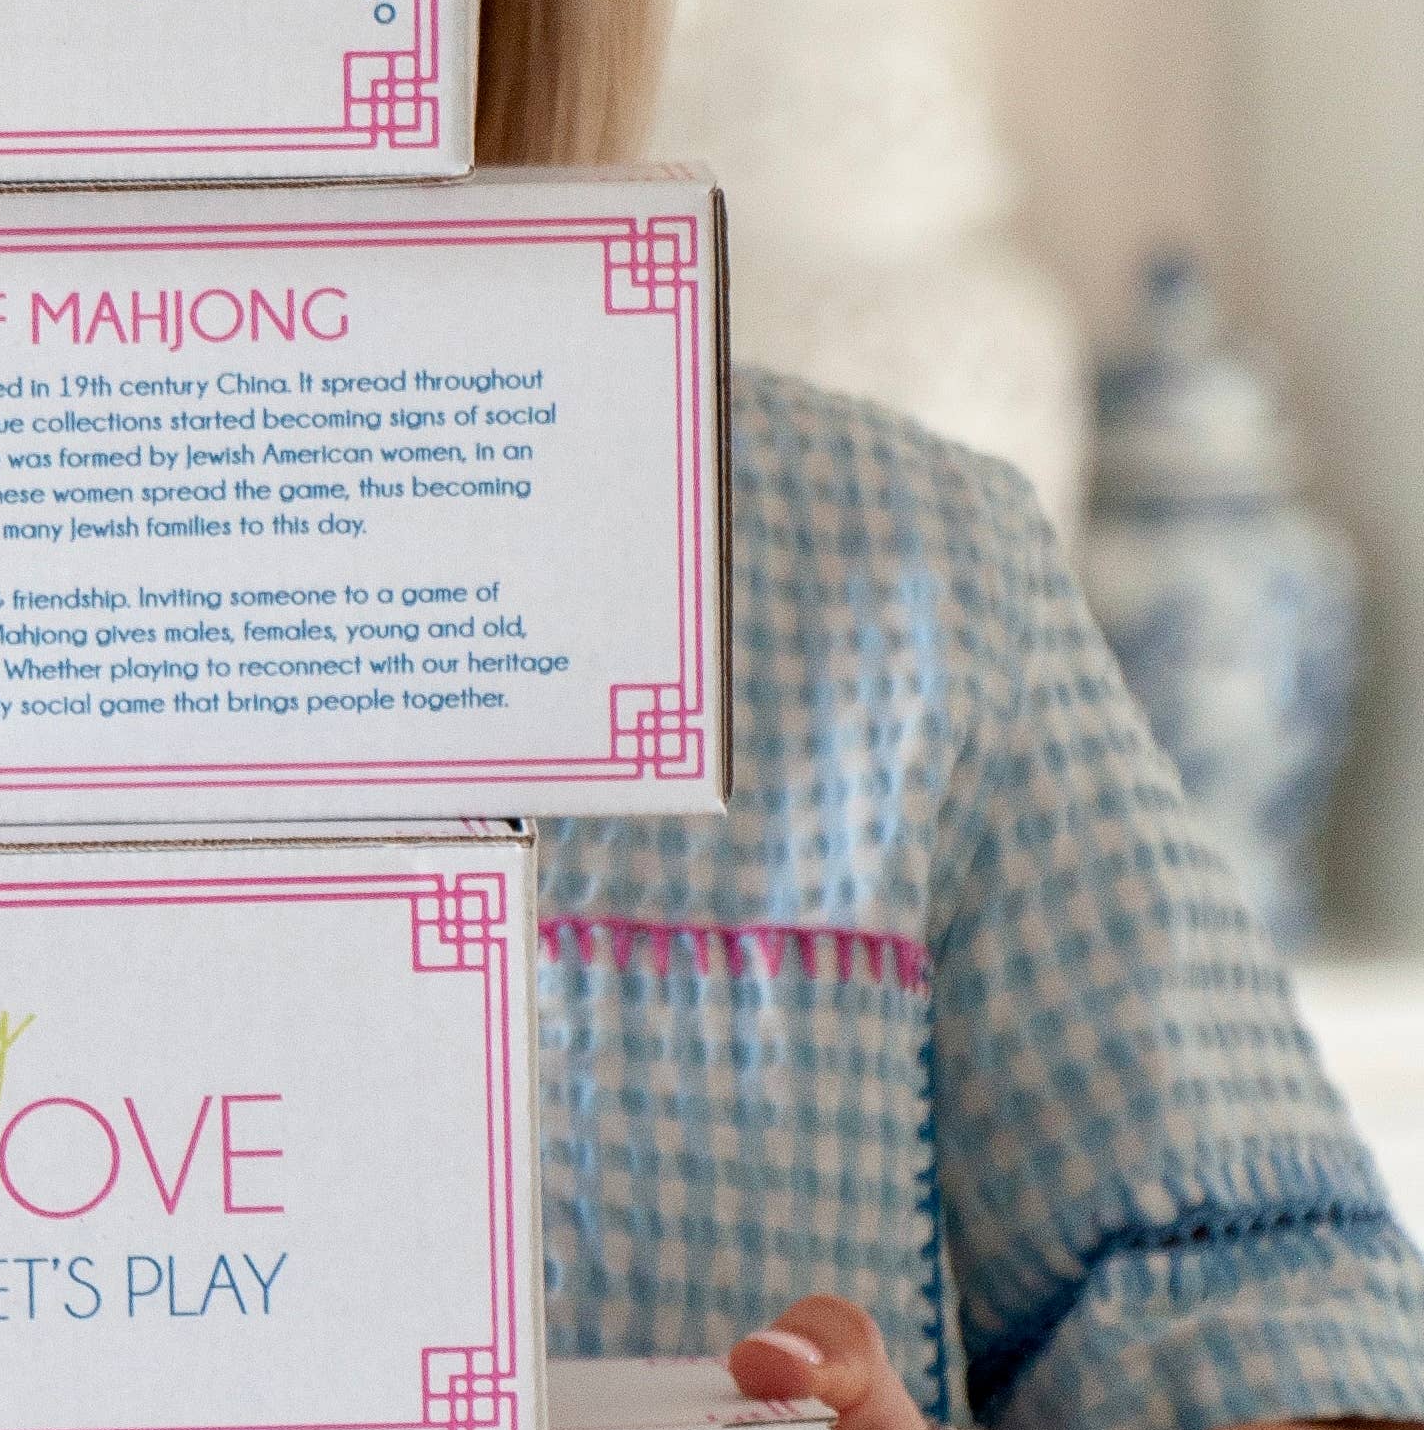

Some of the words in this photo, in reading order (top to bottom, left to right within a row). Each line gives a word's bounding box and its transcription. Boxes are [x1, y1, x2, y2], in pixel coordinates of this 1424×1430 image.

[28, 284, 349, 352] MAHJONG
[28, 379, 51, 396] in
[60, 373, 114, 397] 19th
[118, 375, 209, 397] century
[215, 370, 289, 395] China.
[297, 370, 315, 391] It
[320, 369, 409, 396] spread
[412, 367, 544, 393] throughout
[30, 408, 164, 432] collections
[168, 406, 257, 430] started
[260, 407, 383, 431] becoming
[389, 409, 447, 430] signs
[452, 403, 478, 424] of
[484, 402, 558, 426] social
[7, 451, 53, 469] was
[57, 443, 143, 467] formed
[146, 442, 179, 469] by
[183, 441, 257, 469] Jewish
[260, 440, 374, 465] American
[379, 443, 467, 462] women,
[473, 441, 496, 460] in
[500, 443, 534, 460] an
[51, 484, 135, 504] women
[140, 478, 229, 505] spread
[232, 477, 273, 500] the
[276, 481, 347, 504] game,
[357, 475, 405, 497] thus
[409, 473, 533, 499] becoming
[0, 521, 64, 541] many
[69, 514, 140, 540] Jewish
[144, 514, 233, 538] families
[237, 514, 265, 534] to
[270, 512, 310, 534] this
[316, 511, 364, 535] day.
[10, 586, 130, 612] friendship.
[137, 584, 224, 611] Inviting
[229, 587, 337, 606] someone
[342, 584, 371, 604] to
[375, 586, 396, 603] a
[399, 585, 467, 608] game
[475, 581, 499, 600] of
[93, 622, 158, 648] gives
[162, 619, 234, 643] males,
[242, 617, 337, 642] females,
[345, 620, 421, 642] young
[426, 615, 476, 638] and
[481, 615, 525, 637] old,
[1, 654, 102, 680] Whether
[107, 655, 201, 683] playing
[205, 657, 233, 677] to
[237, 653, 364, 676] reconnect
[367, 650, 416, 674] with
[421, 654, 460, 673] our
[465, 648, 570, 676] heritage
[19, 692, 93, 715] social
[96, 696, 166, 719] game
[172, 689, 221, 713] that
[225, 688, 300, 715] brings
[303, 684, 395, 715] people
[400, 685, 505, 712] together.
[124, 1249, 289, 1319] PLAY
